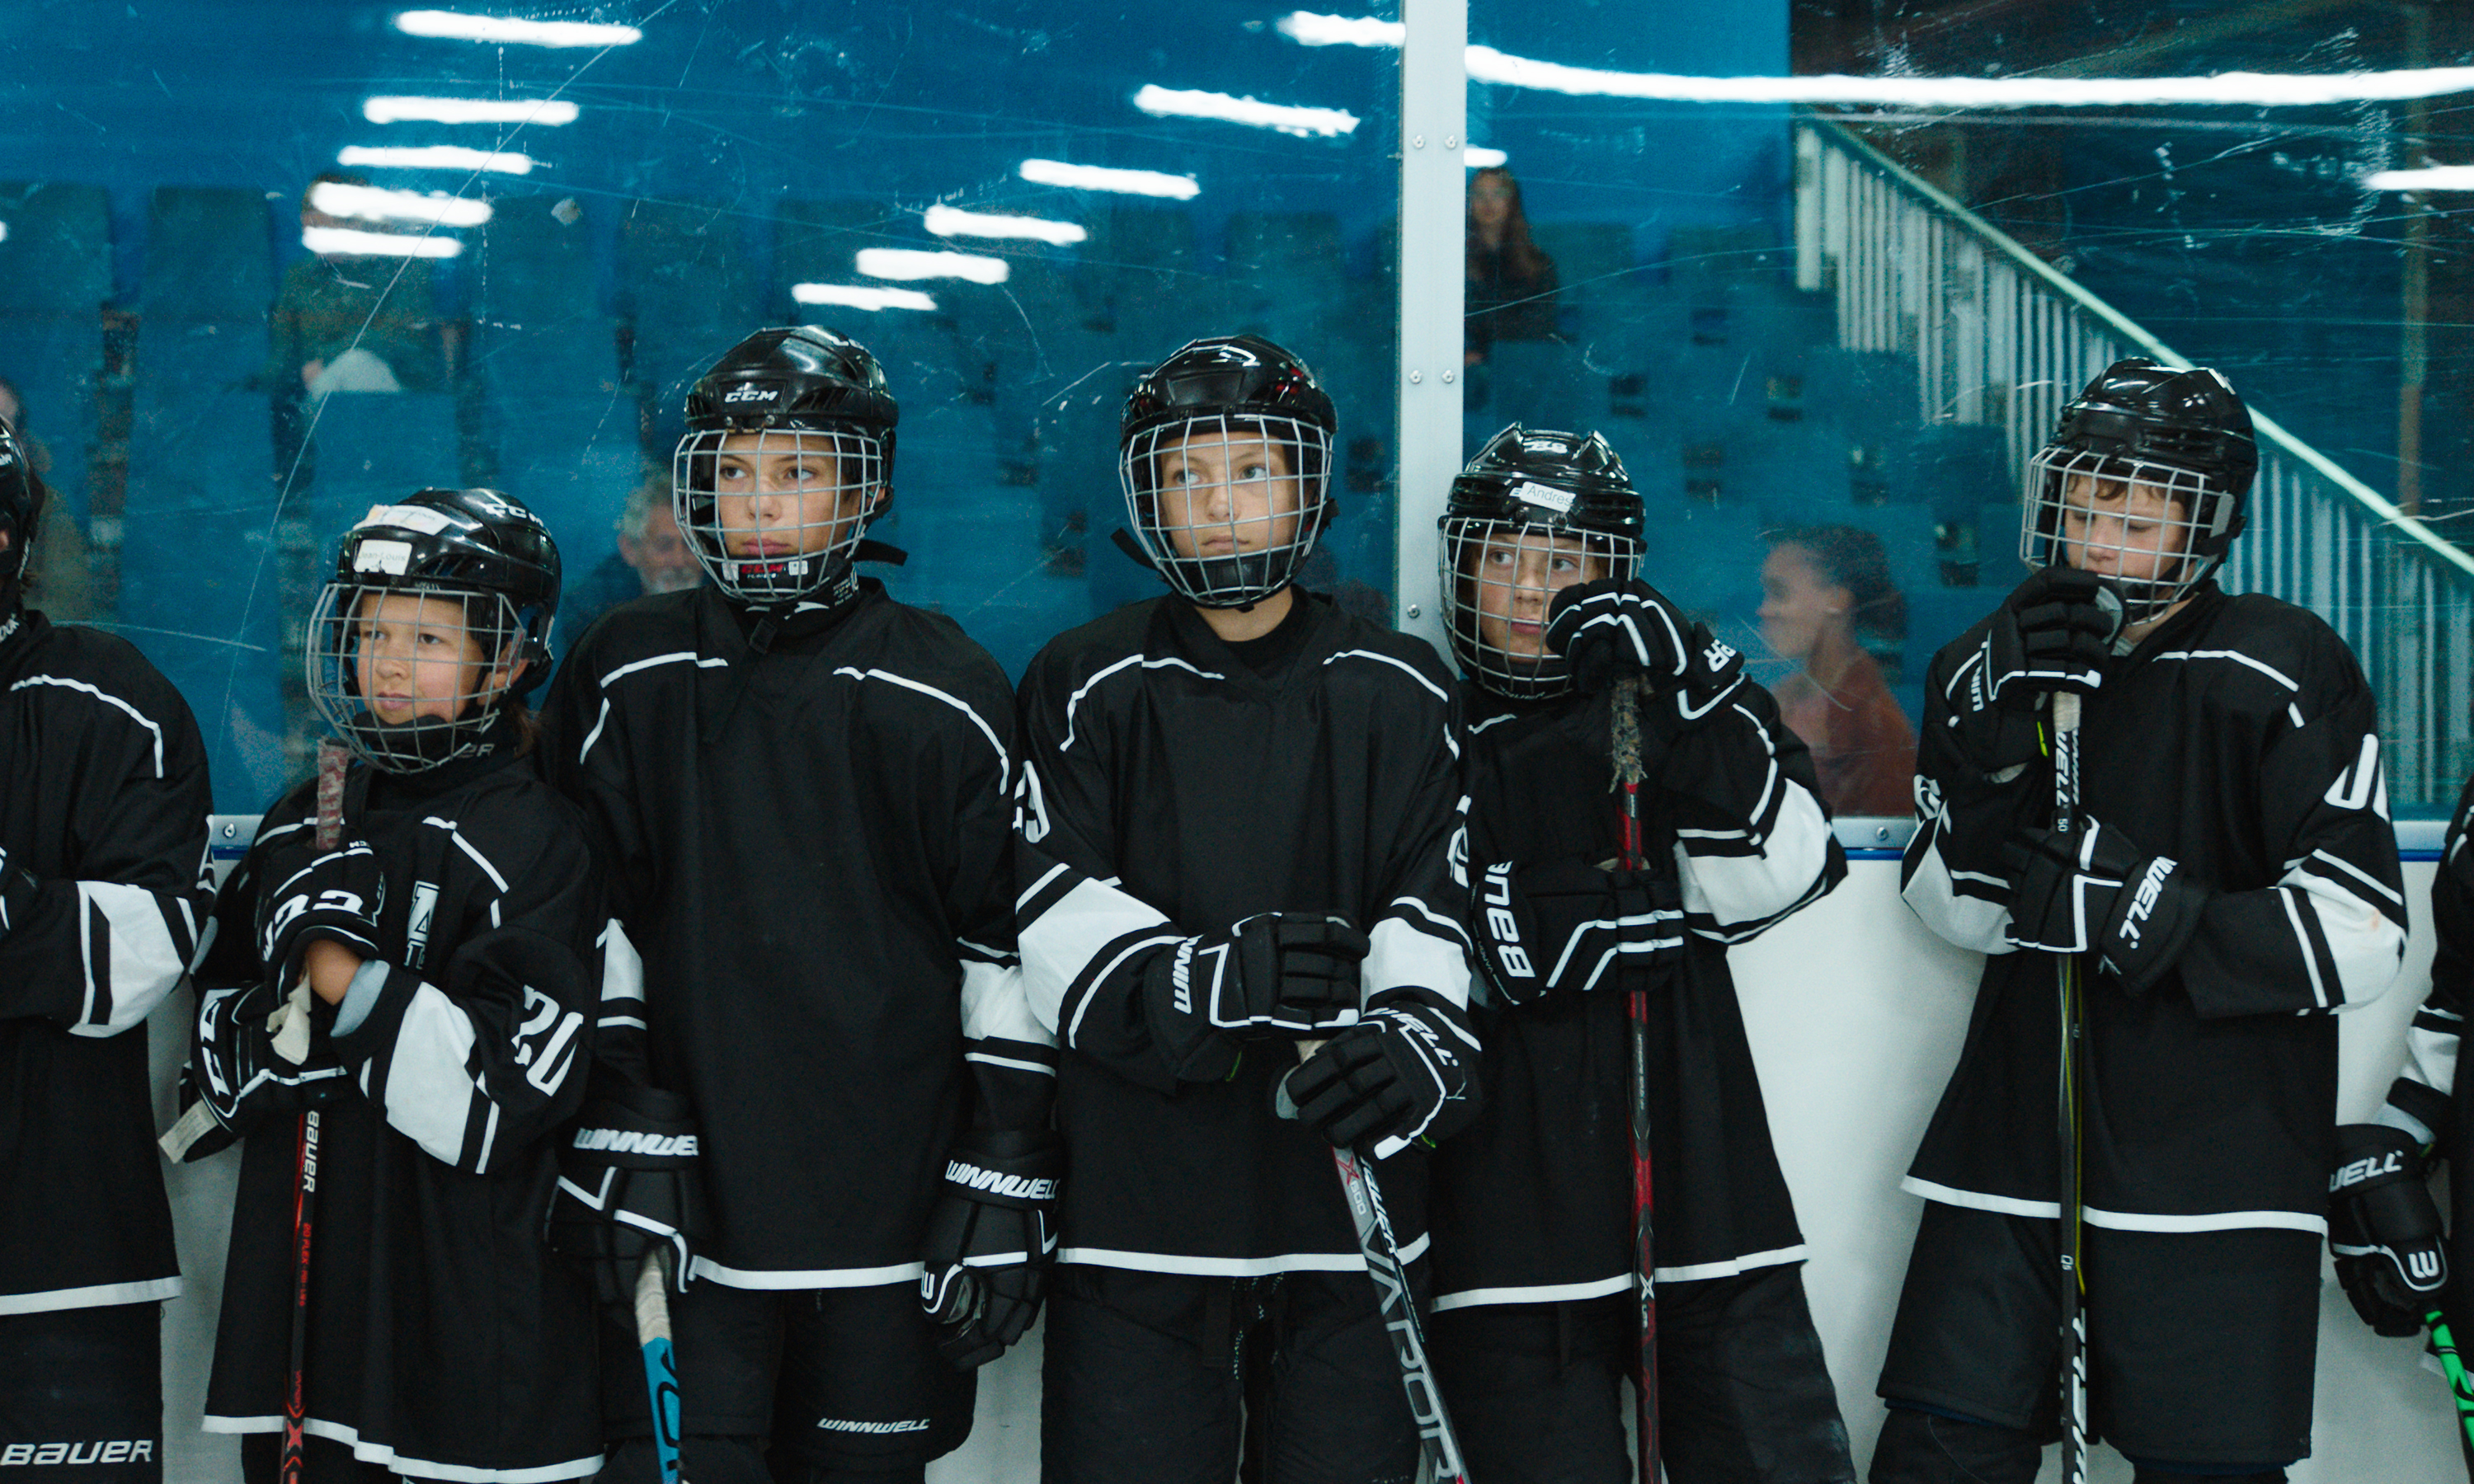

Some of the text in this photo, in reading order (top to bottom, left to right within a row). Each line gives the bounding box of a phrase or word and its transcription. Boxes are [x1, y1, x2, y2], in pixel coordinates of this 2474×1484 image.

[725, 391, 778, 403] CCM
[1526, 485, 1571, 507] Andres
[510, 984, 584, 1097] 20
[303, 1111, 319, 1193] BAUER
[816, 1417, 930, 1434] WINNWELL
[0, 1439, 153, 1466] BAUER
